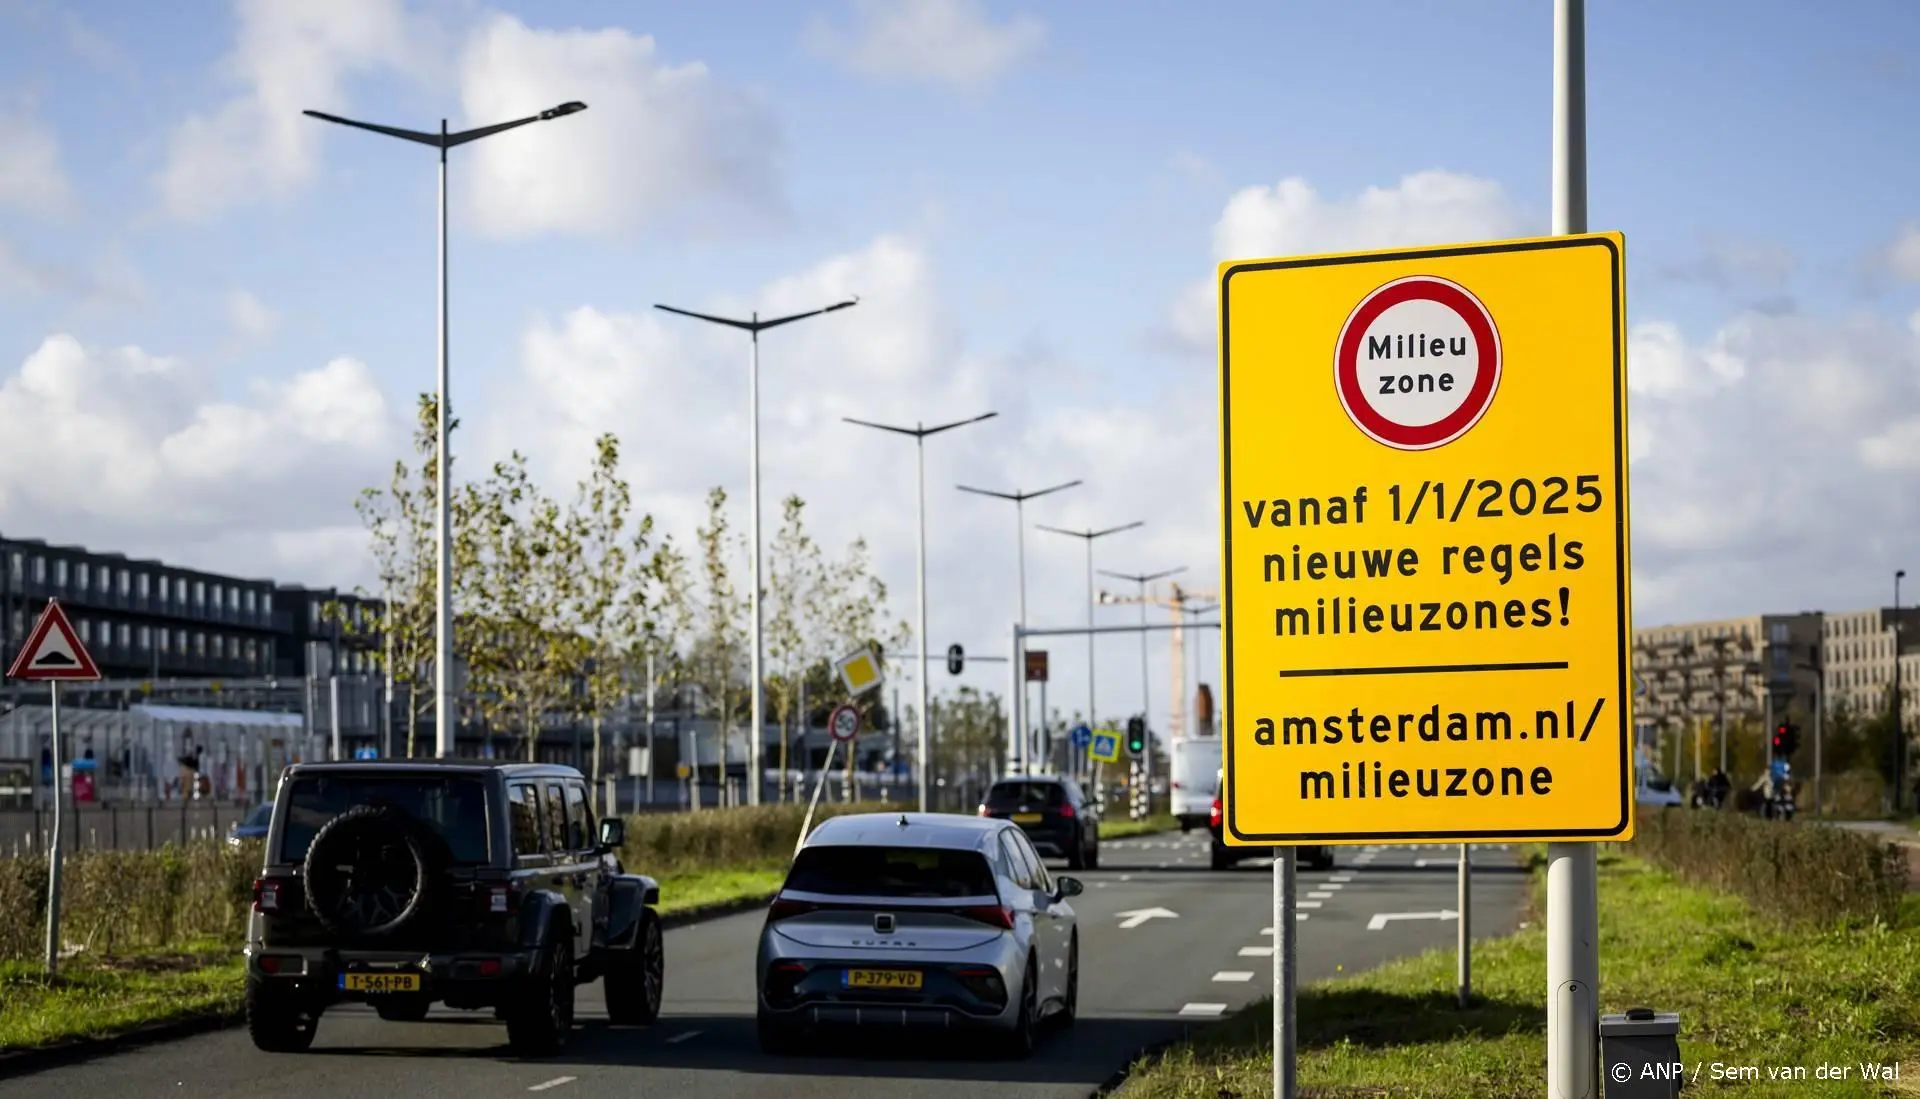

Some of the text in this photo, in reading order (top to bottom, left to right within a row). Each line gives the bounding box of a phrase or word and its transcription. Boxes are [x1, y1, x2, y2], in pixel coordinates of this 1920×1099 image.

[1368, 333, 1466, 360] Milieu
[1379, 372, 1454, 395] zone
[1243, 474, 1603, 529] vanaf 1/1/2025
[1263, 532, 1585, 586] nieuwe regels
[1275, 586, 1570, 637] milieuzones!
[1254, 697, 1606, 746] amsterdam.nl/
[1300, 760, 1553, 800] milieuzone
[853, 970, 917, 987] P-379-VD
